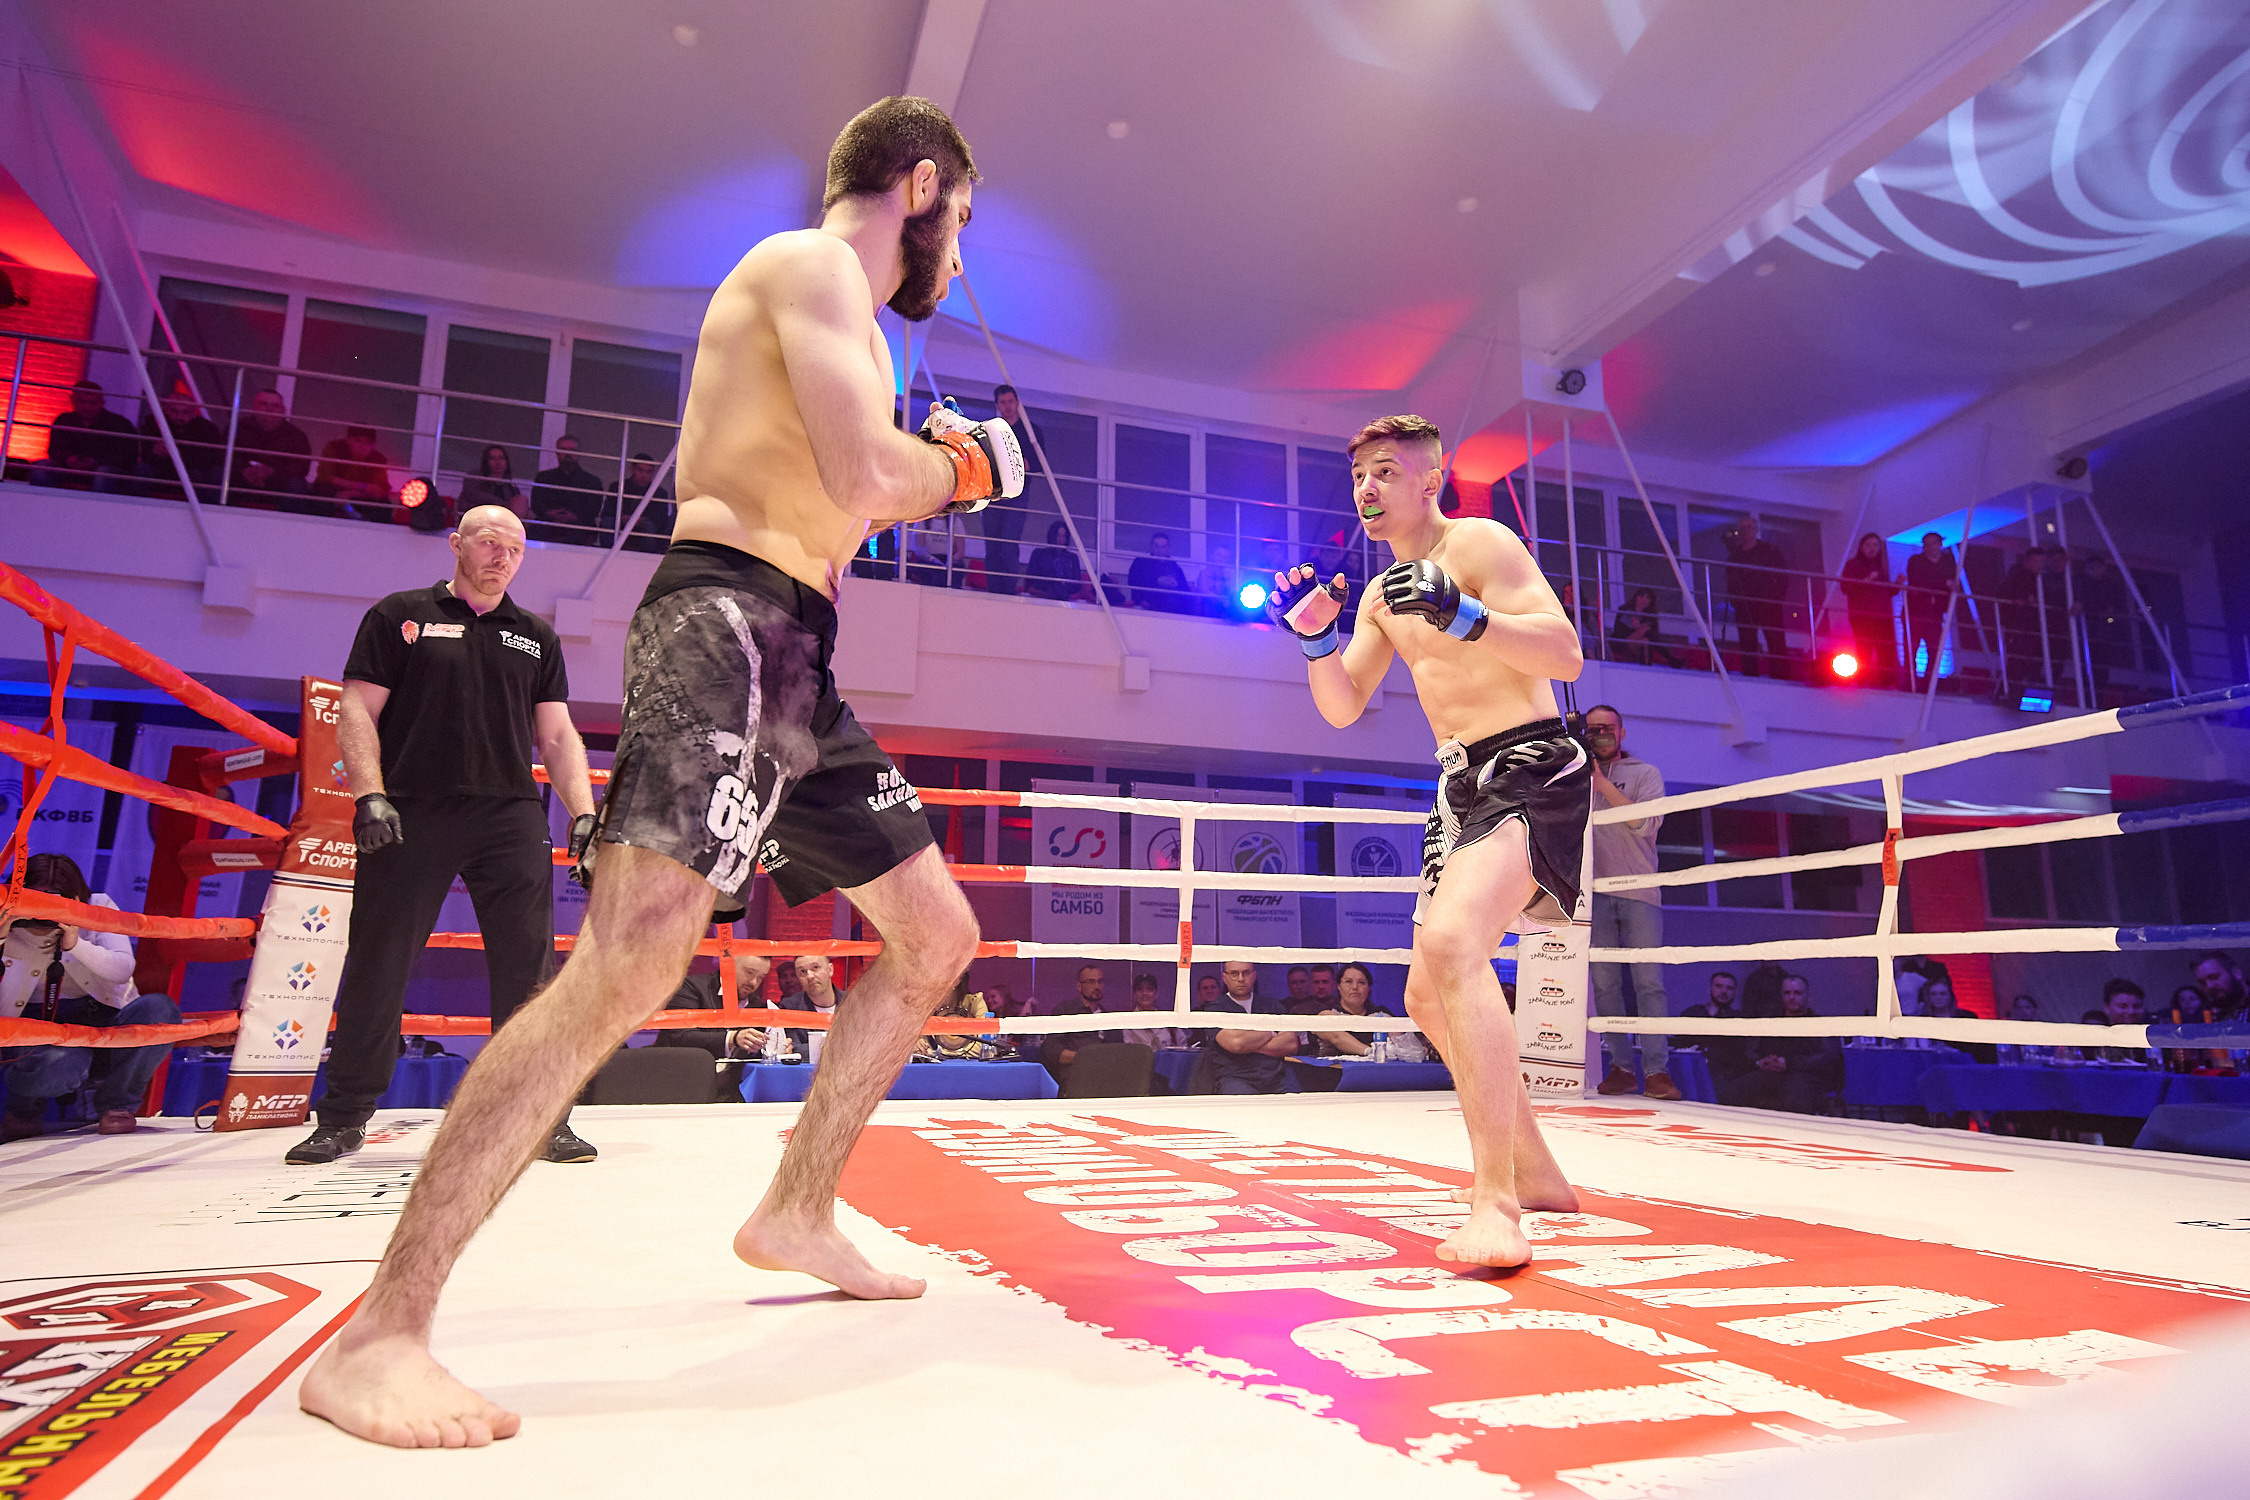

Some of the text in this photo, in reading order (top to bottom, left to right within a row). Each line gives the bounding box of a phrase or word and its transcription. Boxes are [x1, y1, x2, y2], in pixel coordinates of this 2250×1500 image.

[507, 638, 541, 656] СПОРТА
[513, 634, 541, 649] АРЕНА
[1441, 751, 1462, 769] ENUM
[322, 840, 358, 855] АРЕН
[309, 852, 358, 870] СПОРТ
[10, 842, 28, 905] SPARTA
[1065, 891, 1091, 899] РОДОМ
[1051, 900, 1103, 915] САМБО
[719, 925, 733, 948] SPAR
[47, 983, 57, 1010] Canon
[1535, 1076, 1579, 1089] MFP
[252, 1094, 308, 1110] MFP
[912, 1127, 1910, 1500] ЕДИНОБОРСТ
[0, 1331, 230, 1500] МЕБЕЛЬНЫ
